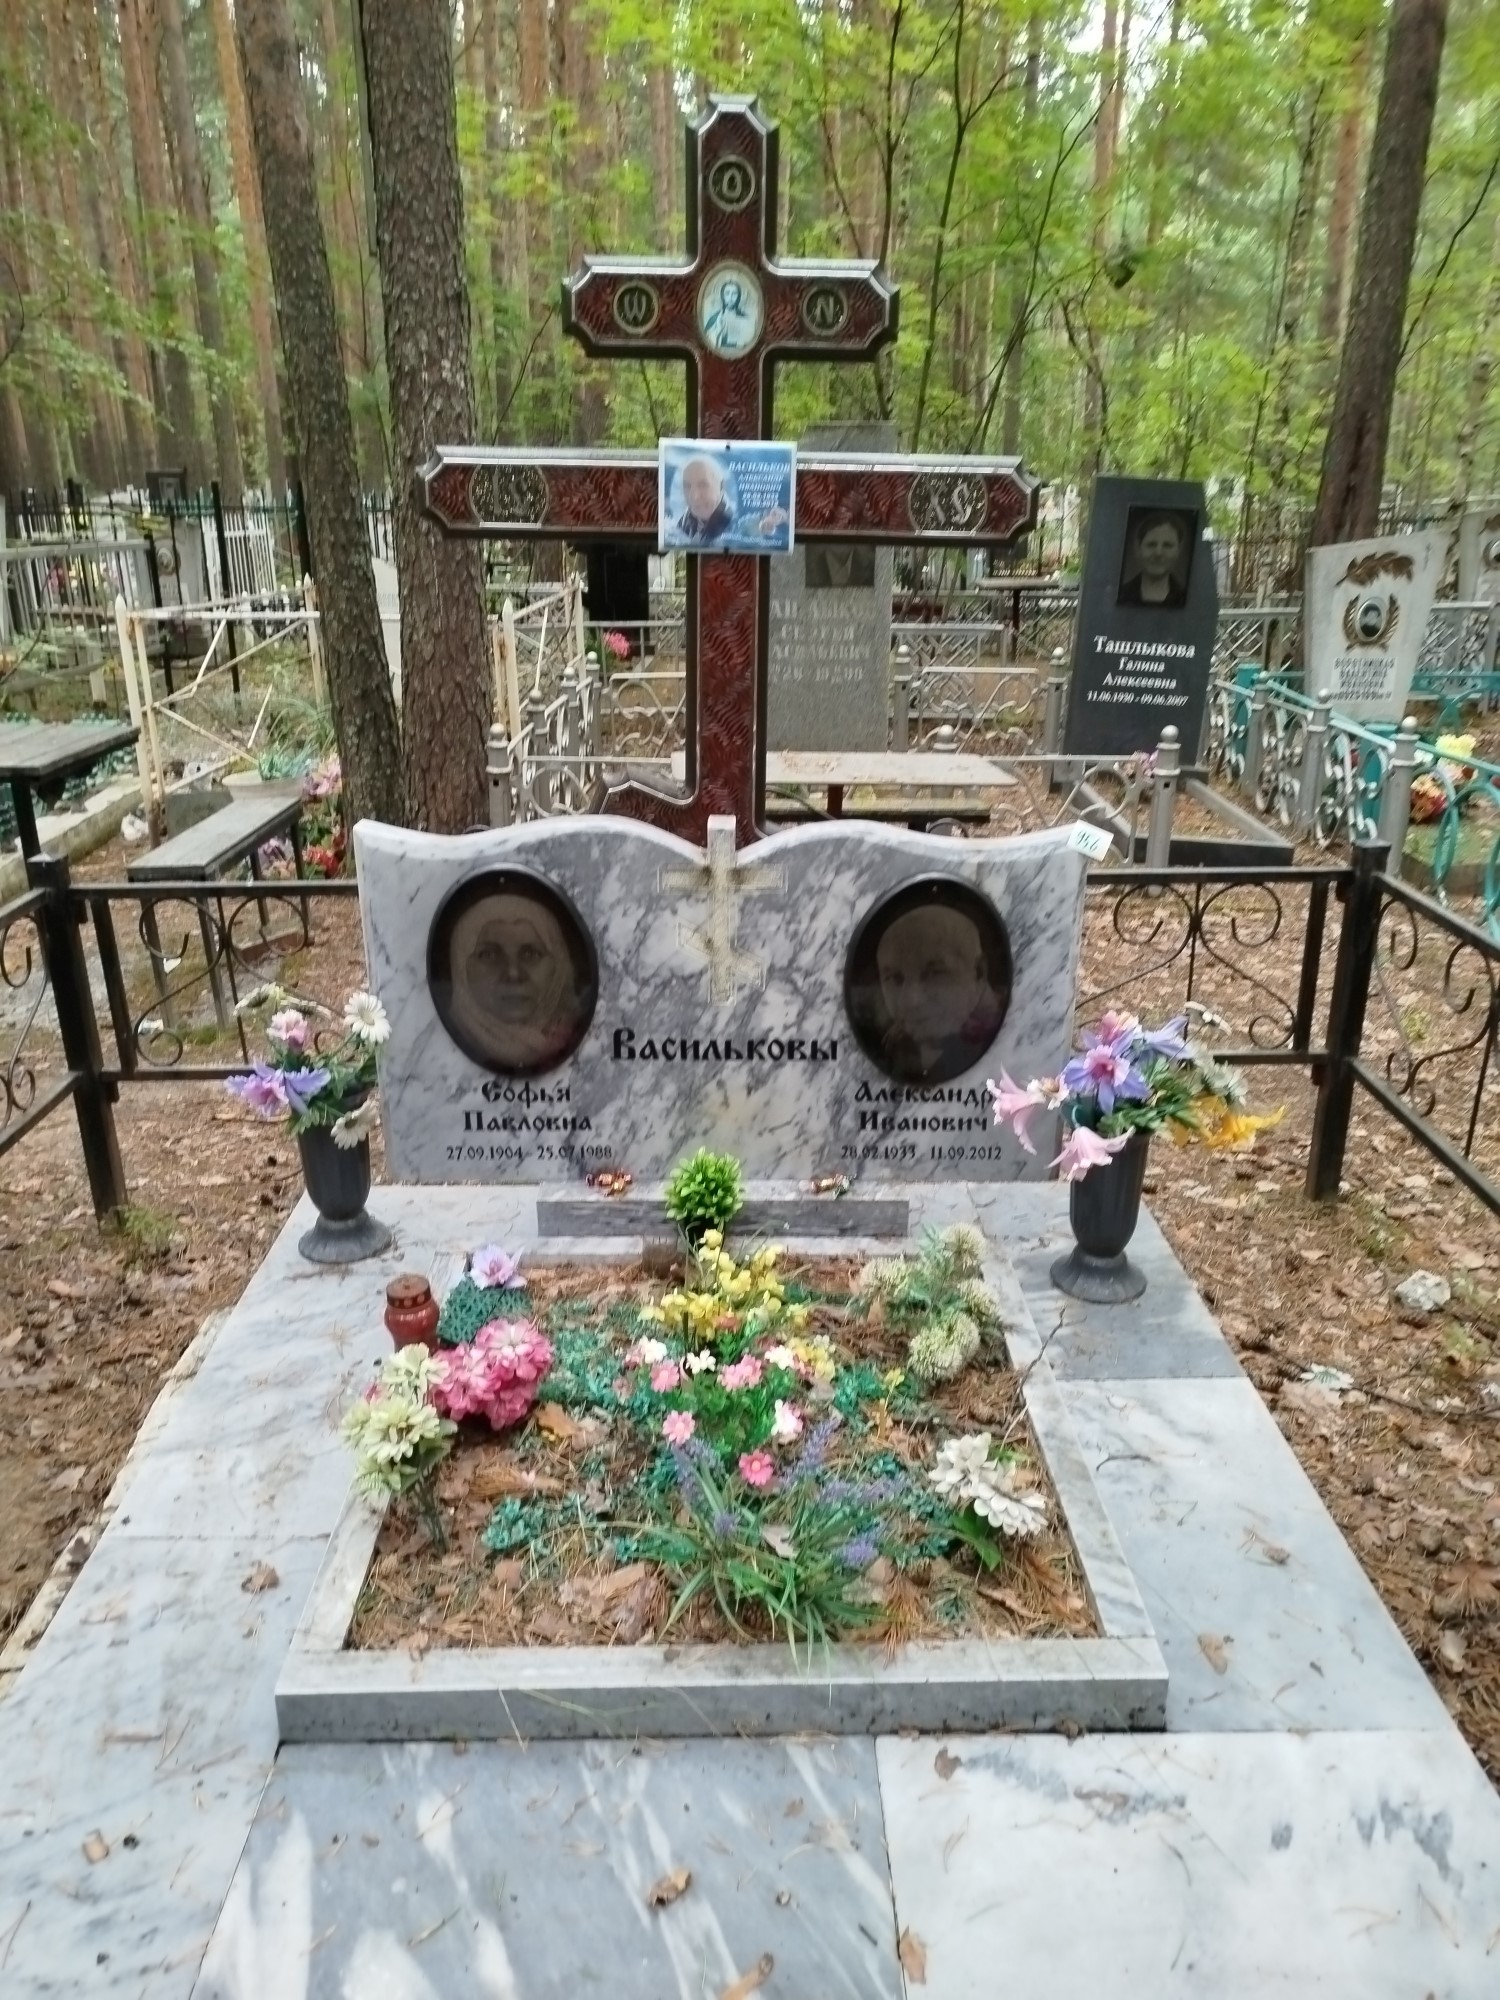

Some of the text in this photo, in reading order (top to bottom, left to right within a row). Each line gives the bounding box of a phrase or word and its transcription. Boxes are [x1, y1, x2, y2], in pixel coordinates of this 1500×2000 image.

[1094, 635, 1196, 659] Ташлыкова
[1118, 656, 1165, 673] Галина
[1102, 671, 1177, 690] Алексеевна
[612, 1026, 838, 1061] Васильковы
[853, 1080, 995, 1109] Александр
[463, 1109, 592, 1132] Павловна
[859, 1110, 988, 1132] Иванович
[447, 1145, 523, 1161] 27.09.1904
[930, 1145, 1002, 1160] 11.09.2012
